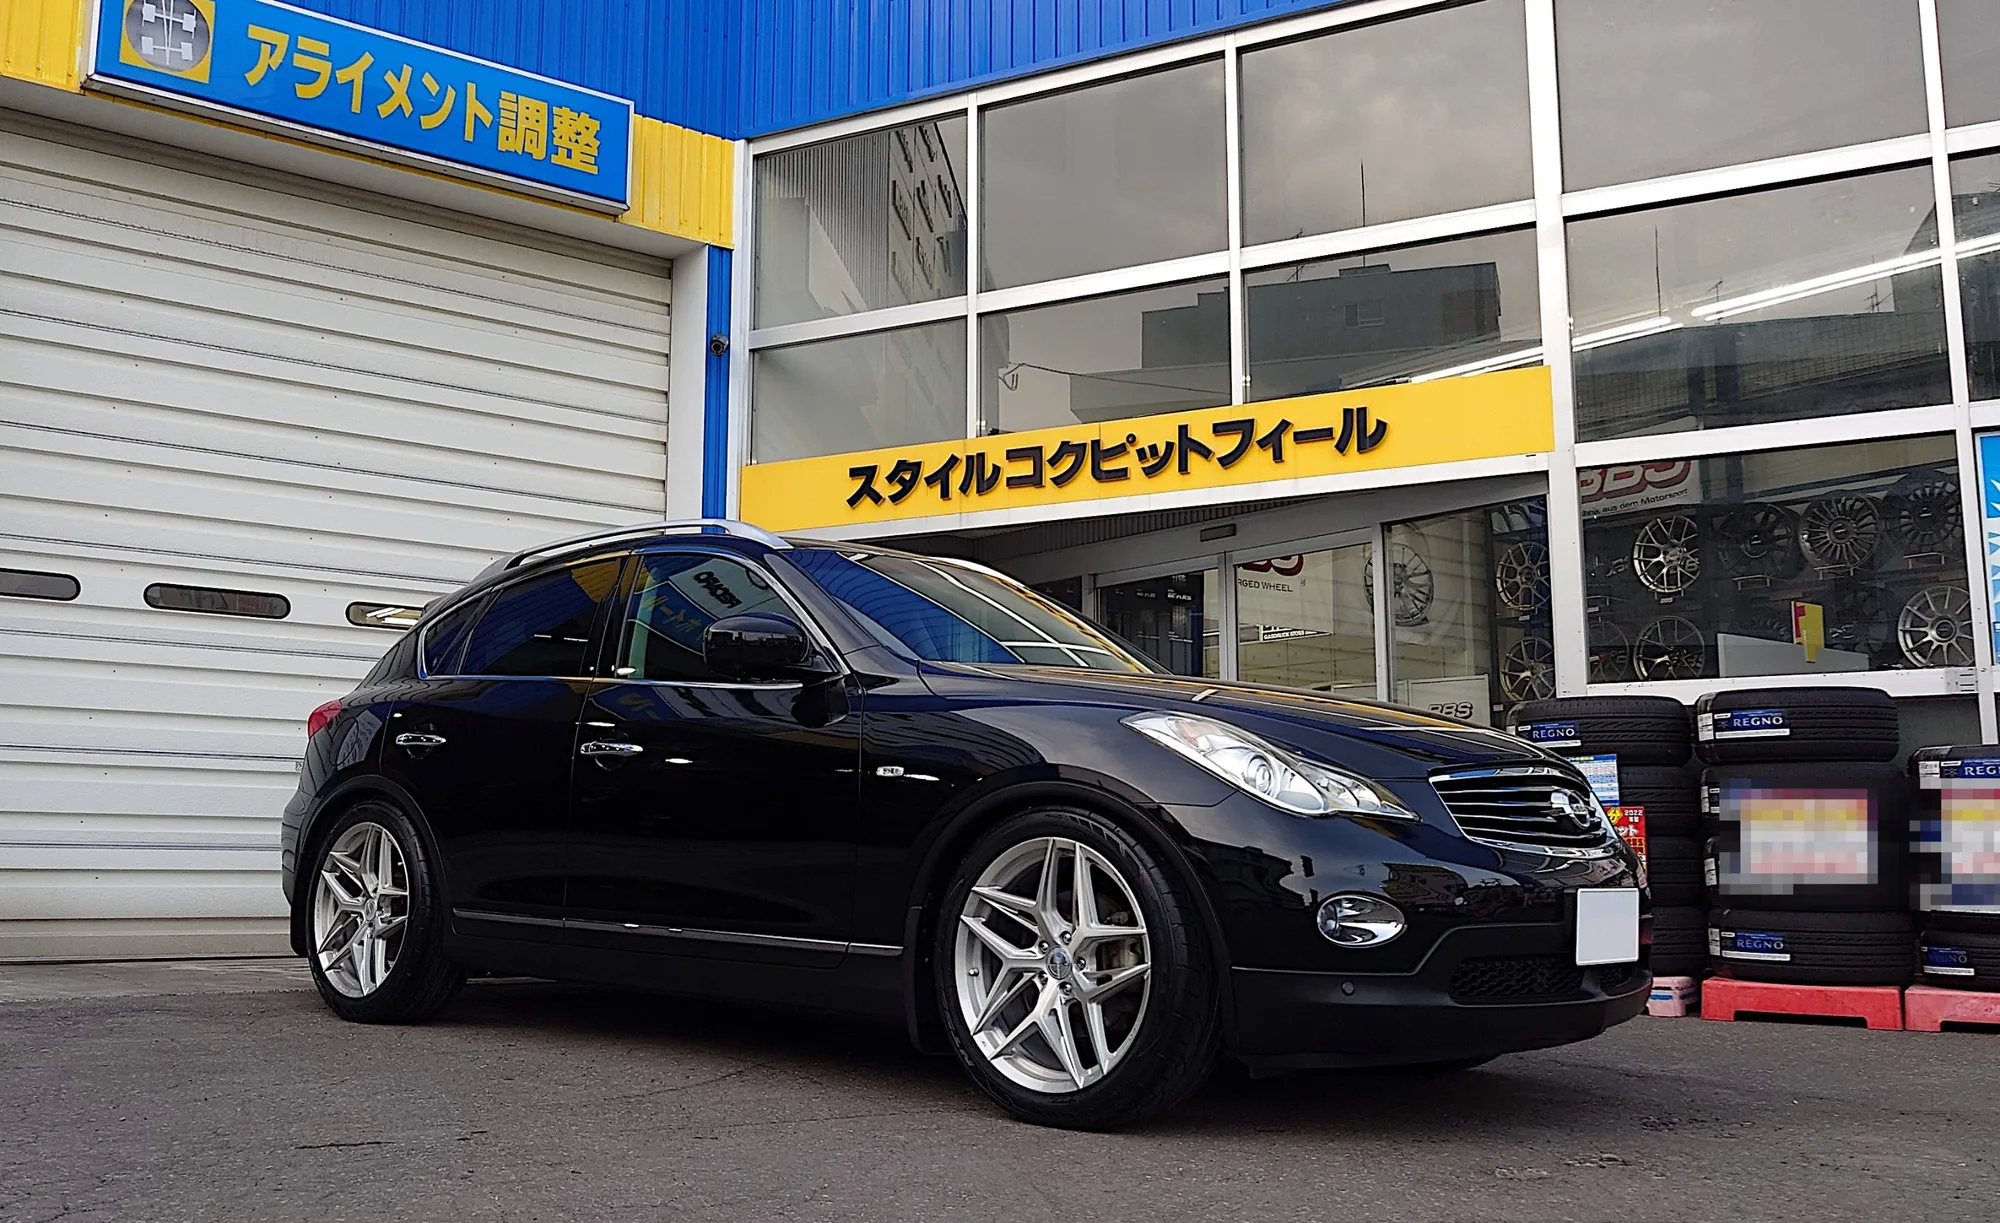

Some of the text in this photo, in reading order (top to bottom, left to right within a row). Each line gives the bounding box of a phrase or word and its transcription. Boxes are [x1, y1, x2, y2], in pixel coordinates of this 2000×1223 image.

[245, 24, 601, 175] アライメント調整
[846, 406, 1388, 509] スタイルコクピットフィール
[1640, 488, 1688, 506] Motorsport
[1262, 581, 1294, 593] WHEEL
[1733, 716, 1783, 727] REGNO
[1532, 728, 1575, 739] REGNO
[1964, 765, 2000, 776] REG
[1736, 939, 1784, 950] REGNO
